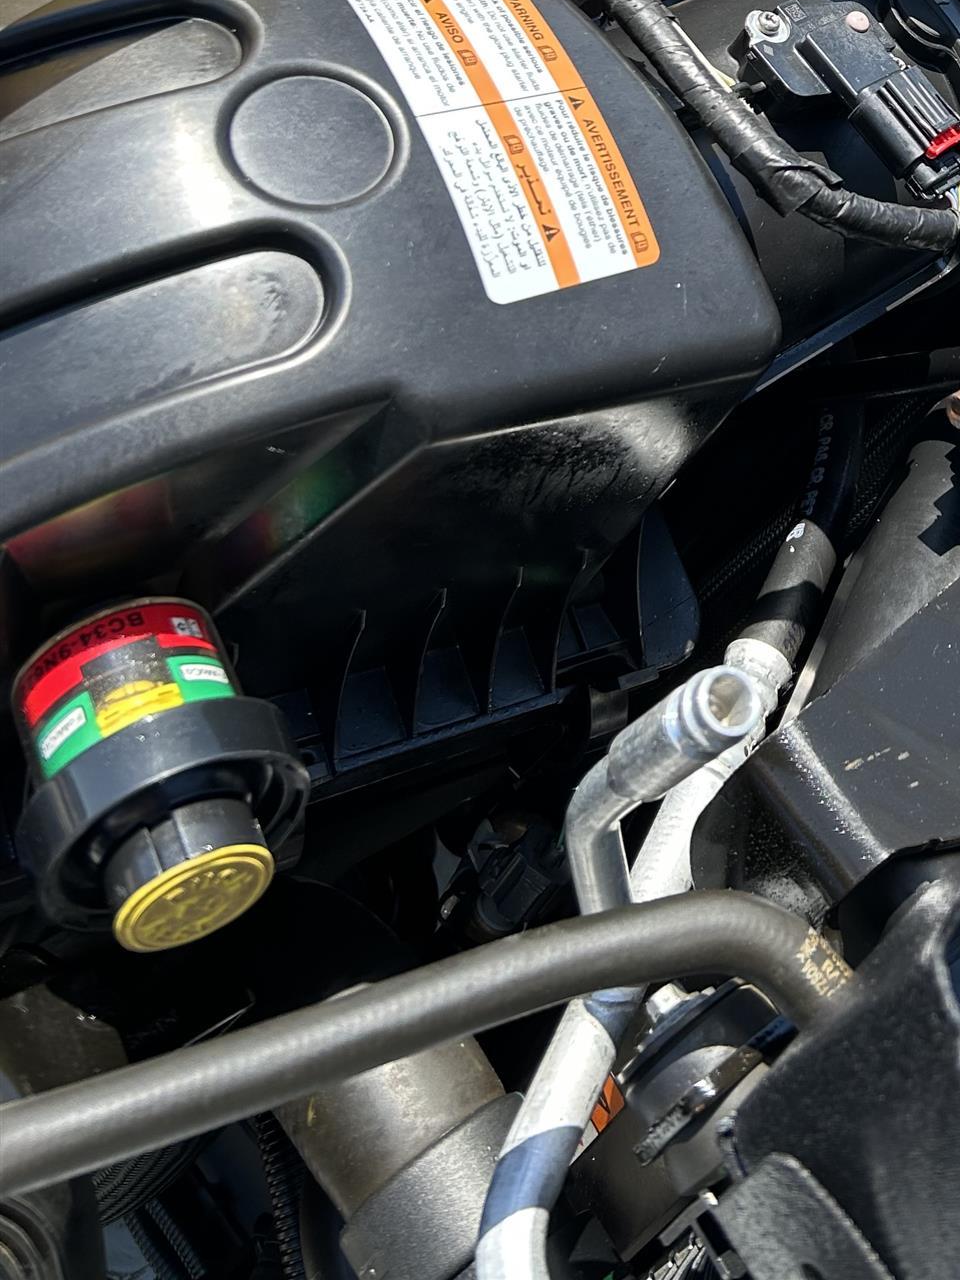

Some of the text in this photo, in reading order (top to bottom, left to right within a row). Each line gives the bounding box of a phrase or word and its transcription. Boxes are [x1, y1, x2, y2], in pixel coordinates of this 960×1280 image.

[434, 11, 465, 43] AVISO
[471, 8, 486, 21] with
[481, 22, 494, 33] the
[487, 34, 505, 50] glow
[499, 14, 526, 43] possible
[520, 45, 545, 73] serious
[414, 30, 427, 40] No
[421, 42, 434, 54] use
[429, 56, 452, 81] fluidos
[445, 83, 458, 92] de
[418, 17, 438, 39] riesgo
[434, 41, 446, 50] de
[440, 52, 466, 85] lesiones
[486, 11, 499, 21] Do
[493, 21, 506, 32] not
[501, 33, 514, 46] use
[509, 47, 530, 69] starter
[523, 71, 543, 91] fluids
[498, 51, 516, 67] plug
[508, 69, 531, 92] starter
[513, 107, 524, 117] de
[523, 104, 595, 248] avec ce moteur équipé de bougies
[543, 100, 564, 130] graves
[559, 131, 570, 143] ou
[565, 144, 577, 155] de
[598, 223, 612, 240] pas
[605, 242, 618, 254] de
[555, 99, 631, 255] Pour réduire le risque de blessures
[582, 118, 640, 227] AVERTISSEMENT
